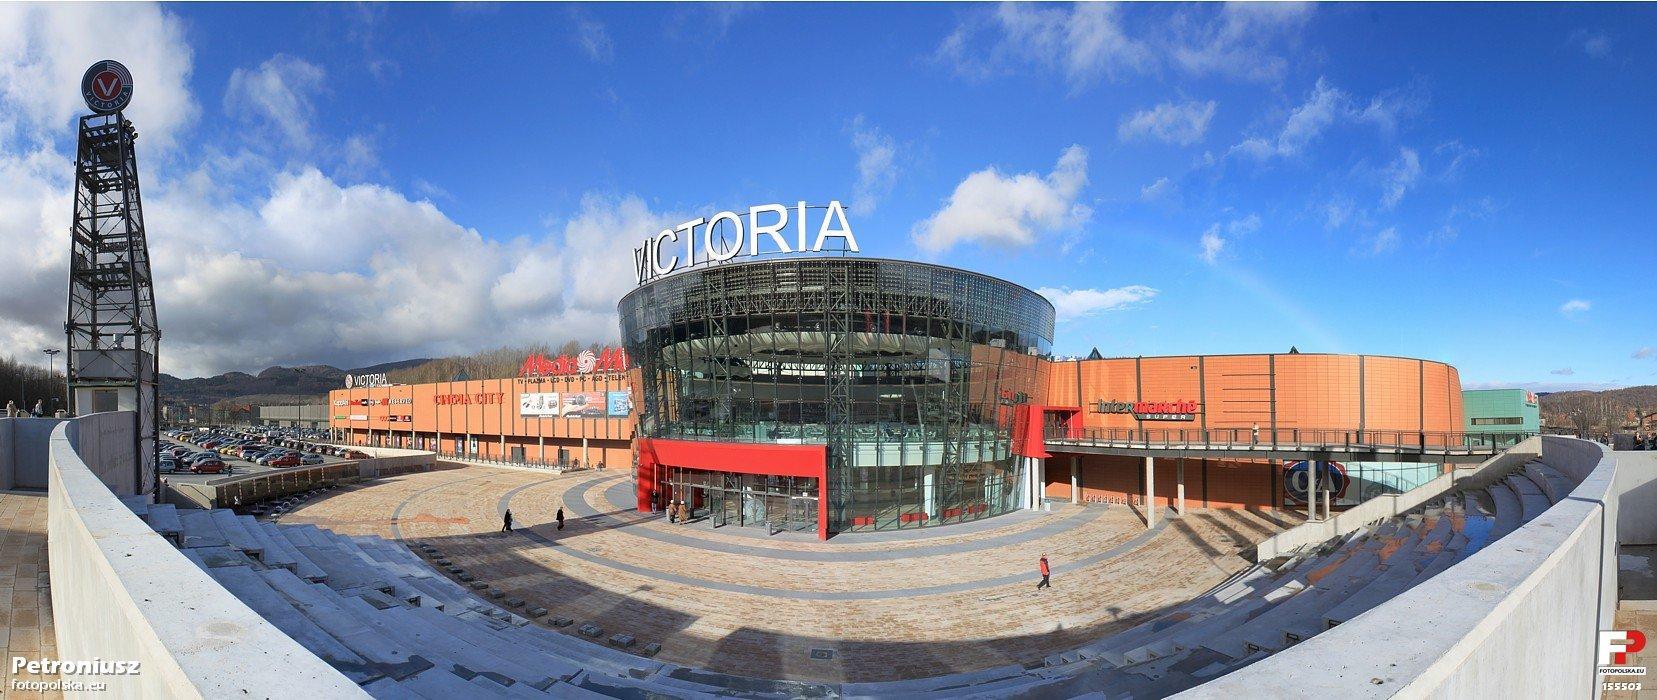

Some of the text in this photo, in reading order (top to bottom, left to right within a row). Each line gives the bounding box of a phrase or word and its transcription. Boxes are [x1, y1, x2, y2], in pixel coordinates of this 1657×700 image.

[97, 78, 119, 97] V
[86, 91, 129, 108] VICTORIA
[632, 200, 860, 285] VICTORIA
[354, 373, 388, 387] VICTORIA
[475, 391, 505, 405] CITY
